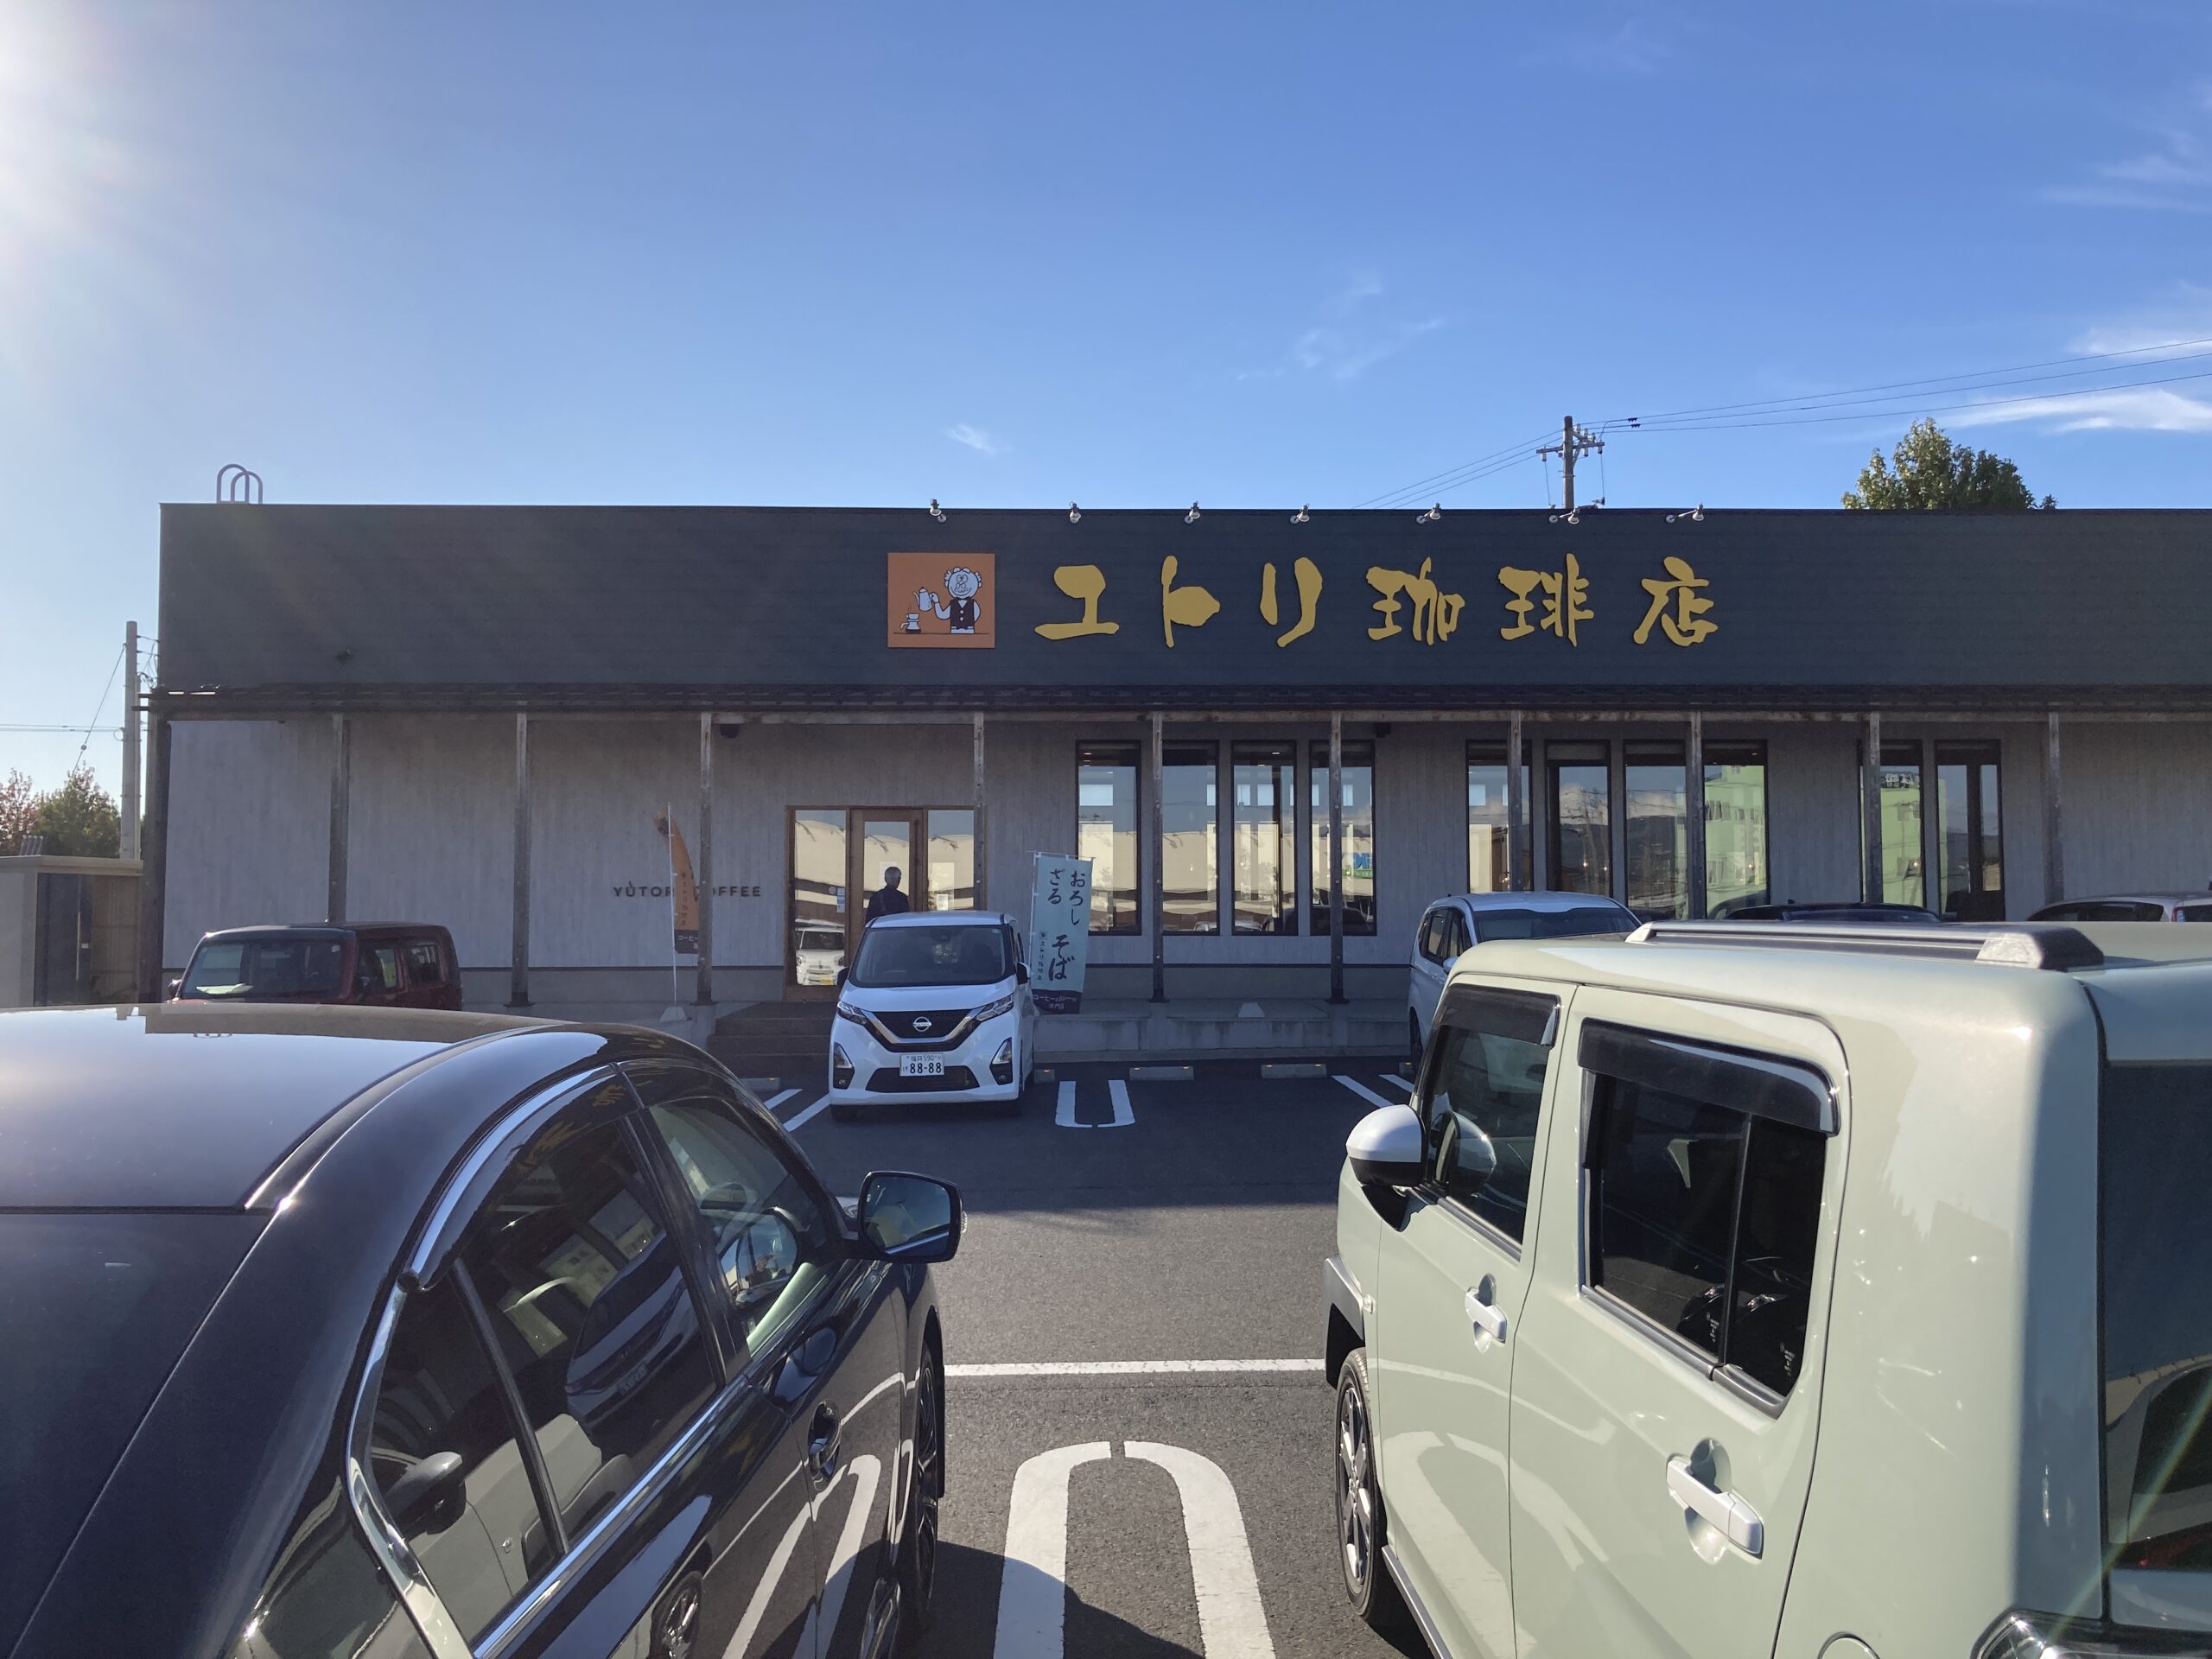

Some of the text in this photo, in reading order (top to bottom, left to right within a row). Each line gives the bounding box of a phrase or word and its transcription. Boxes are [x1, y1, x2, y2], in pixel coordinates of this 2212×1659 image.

[1034, 553, 1719, 649] ユトリ珈琲店
[1047, 868, 1065, 905] ざる
[1069, 870, 1085, 925] おろし
[1048, 934, 1074, 982] そば
[910, 1062, 942, 1074] 88-88
